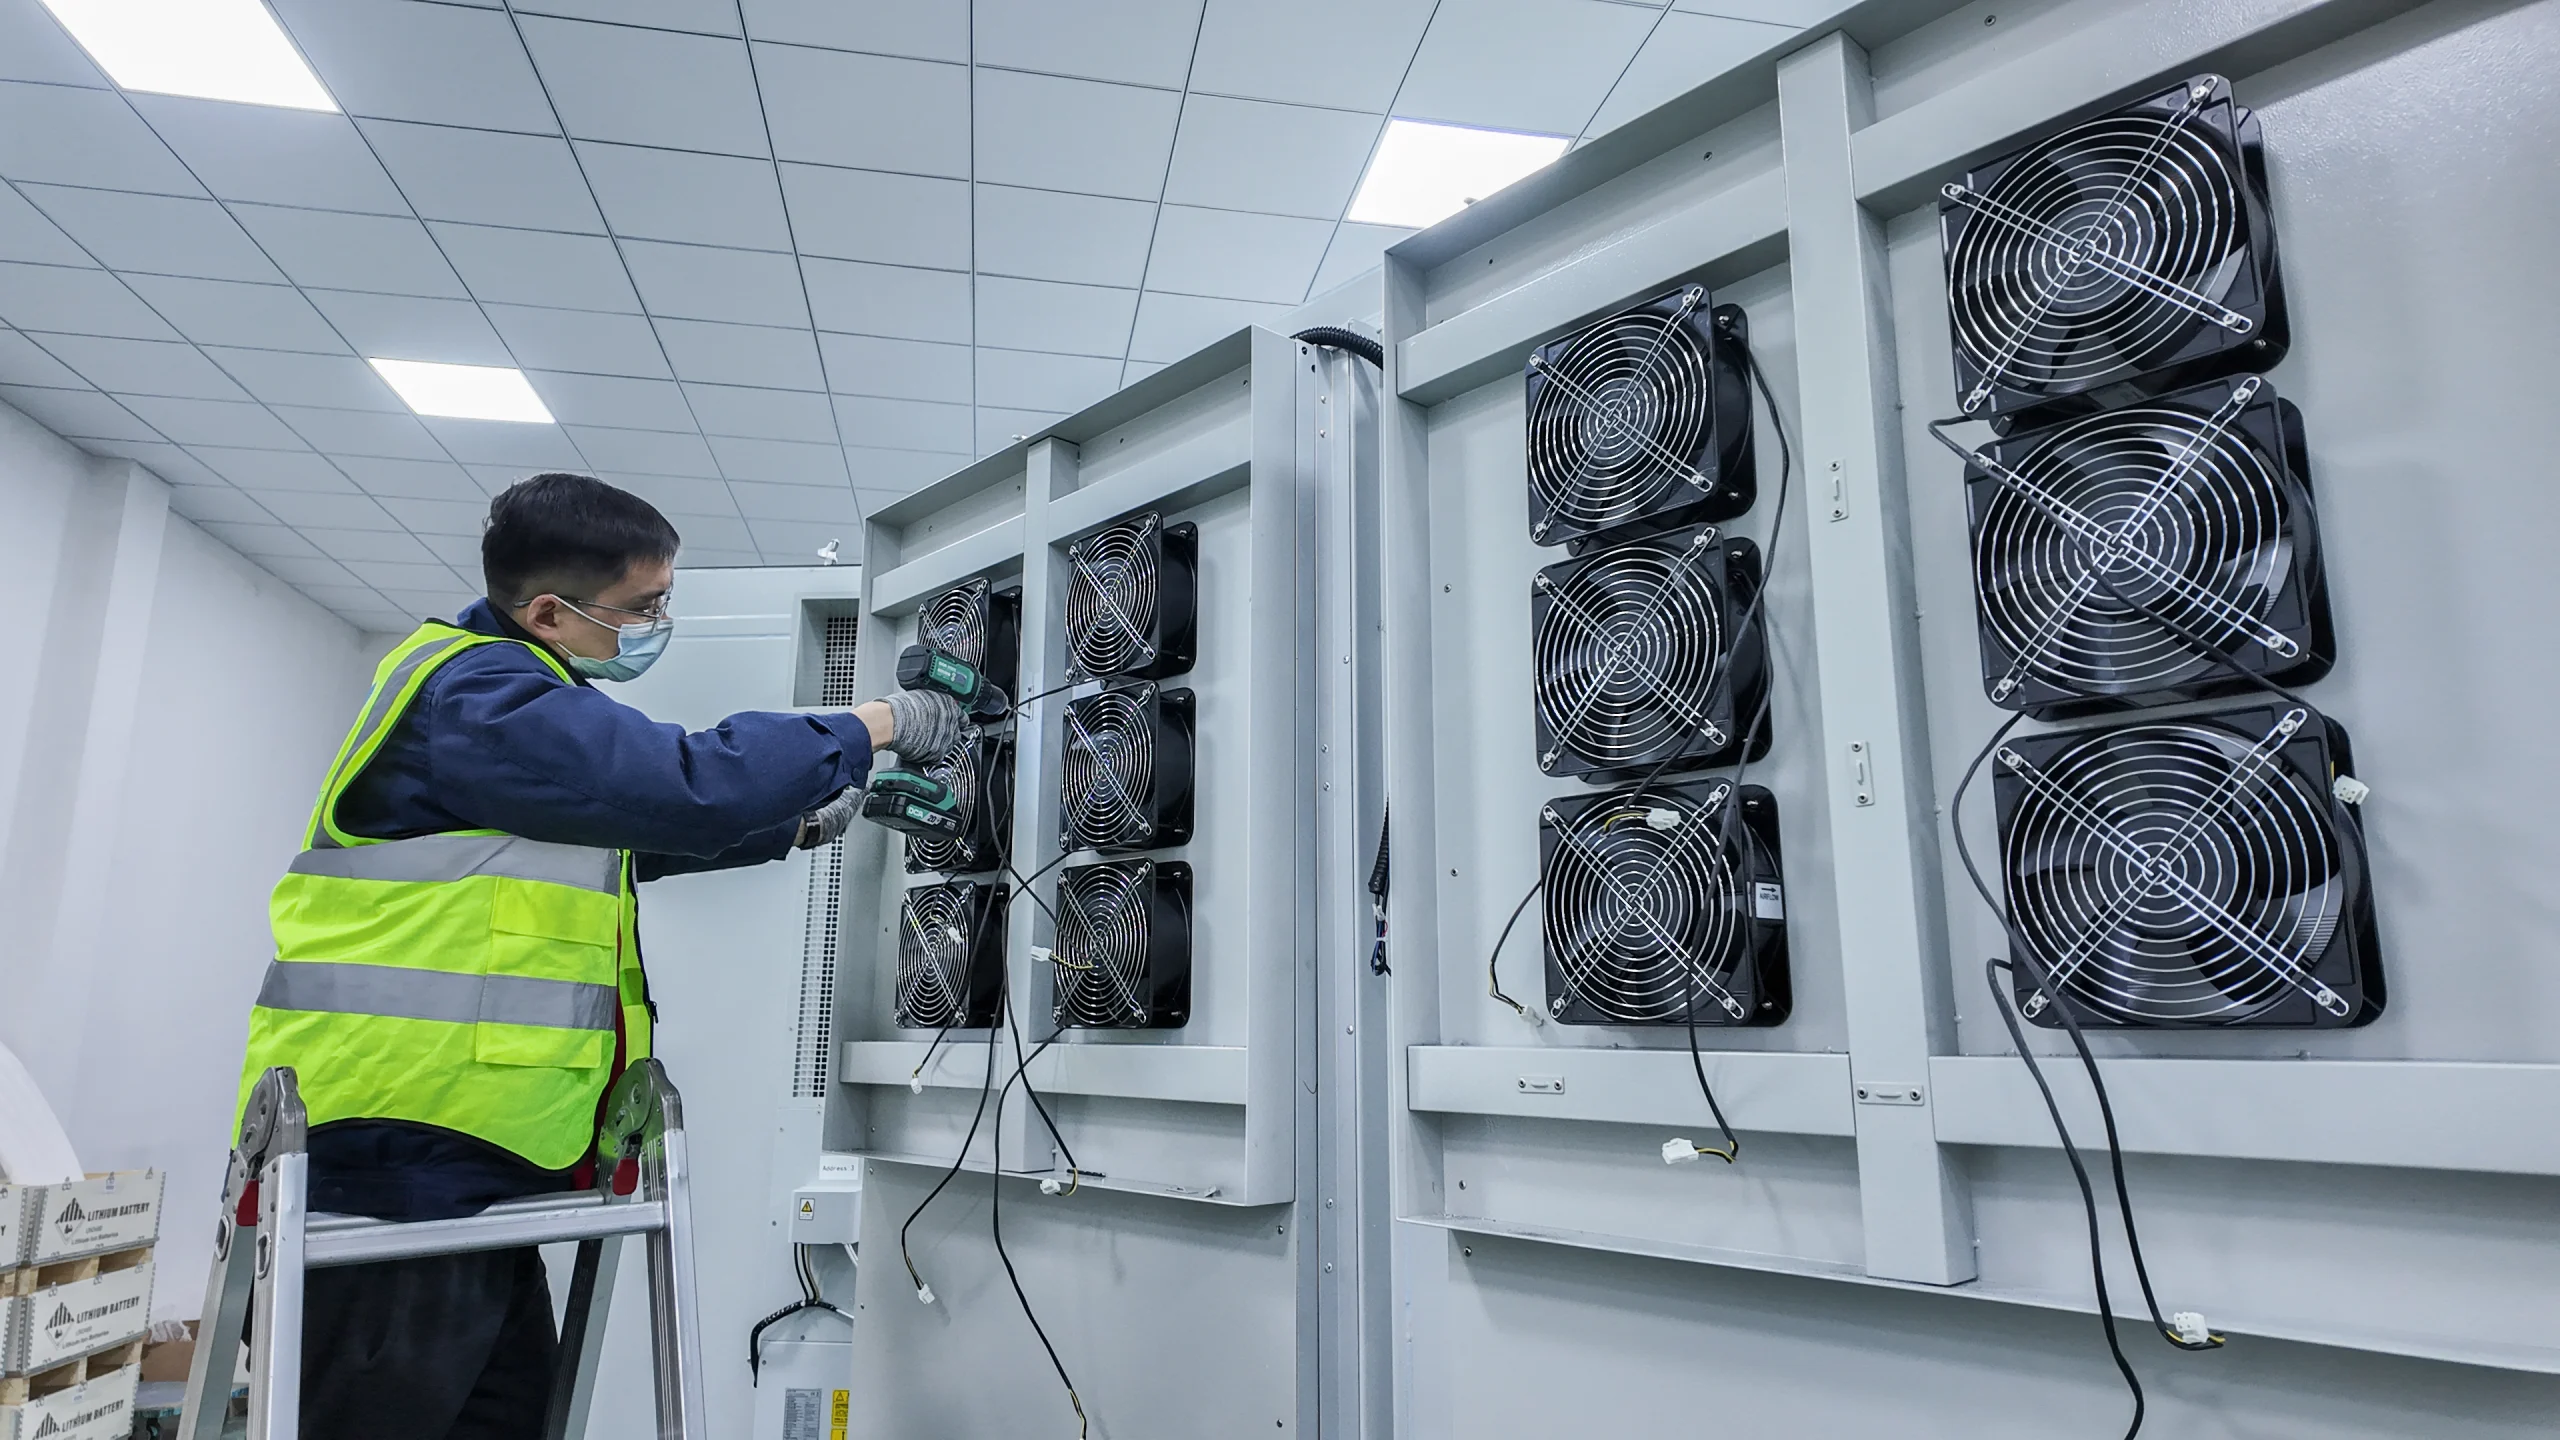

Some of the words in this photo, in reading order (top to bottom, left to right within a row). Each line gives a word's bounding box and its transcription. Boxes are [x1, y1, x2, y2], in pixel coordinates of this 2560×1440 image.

[908, 806, 924, 819] DCA
[1760, 892, 1779, 901] AIRFLOW
[87, 1207, 119, 1222] LITHIUM
[119, 1202, 150, 1217] BATTERY
[76, 1305, 108, 1324] LITHIUM
[109, 1295, 140, 1314] BATTERY
[62, 1411, 93, 1433] LITHIUM
[93, 1399, 125, 1420] BATTERY
